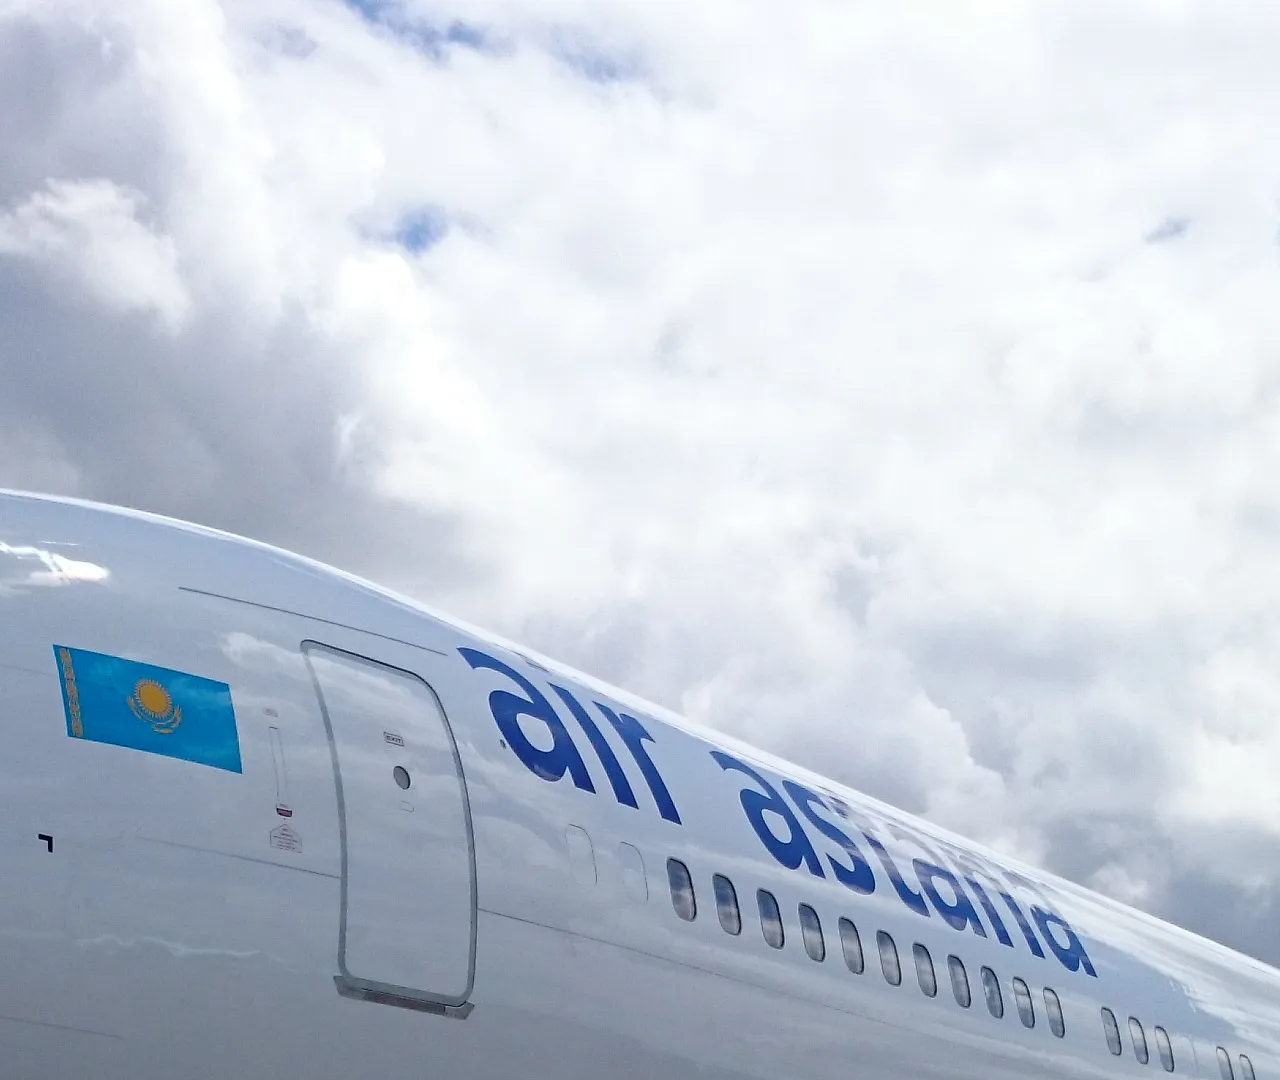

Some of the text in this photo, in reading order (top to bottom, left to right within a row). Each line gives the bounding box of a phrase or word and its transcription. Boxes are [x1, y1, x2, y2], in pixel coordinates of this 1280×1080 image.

[385, 735, 402, 745] EXIT
[457, 647, 1098, 978] air astana
